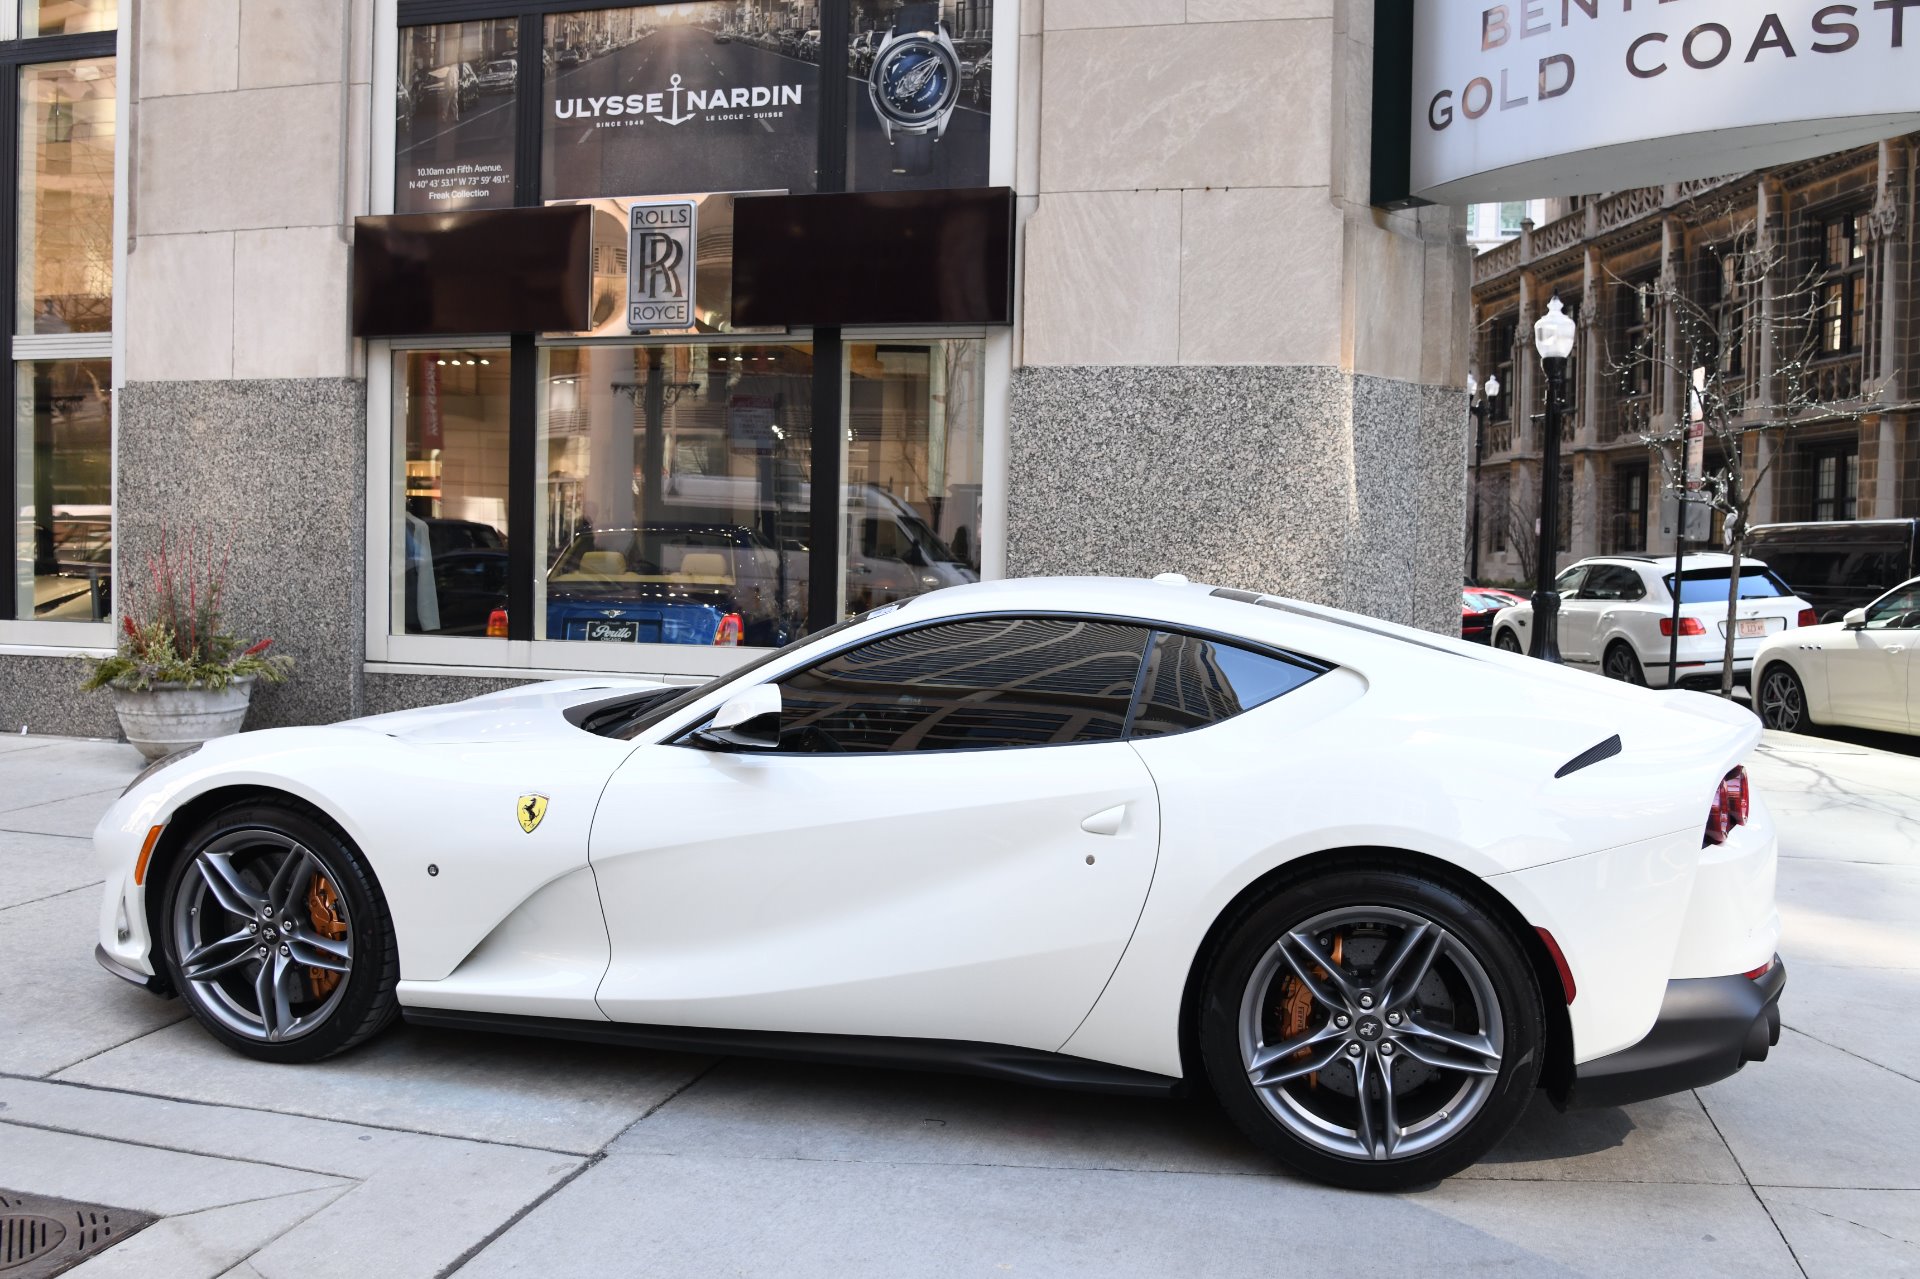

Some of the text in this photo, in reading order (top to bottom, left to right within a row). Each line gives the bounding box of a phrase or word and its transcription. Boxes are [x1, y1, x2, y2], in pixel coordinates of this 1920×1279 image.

[1428, 0, 1920, 132] GOLD COAST
[555, 84, 802, 119] ULYSSE NARDIN
[718, 113, 744, 121] LOCLE
[753, 111, 784, 119] SUISSE
[596, 121, 622, 129] SINCE
[417, 167, 444, 176] 10.10am
[456, 164, 473, 174] Fifth
[409, 181, 416, 189] N
[458, 177, 467, 186] W
[428, 189, 490, 200] Freak Collection
[635, 208, 687, 225] ROLLS
[633, 305, 685, 321] ROYCE
